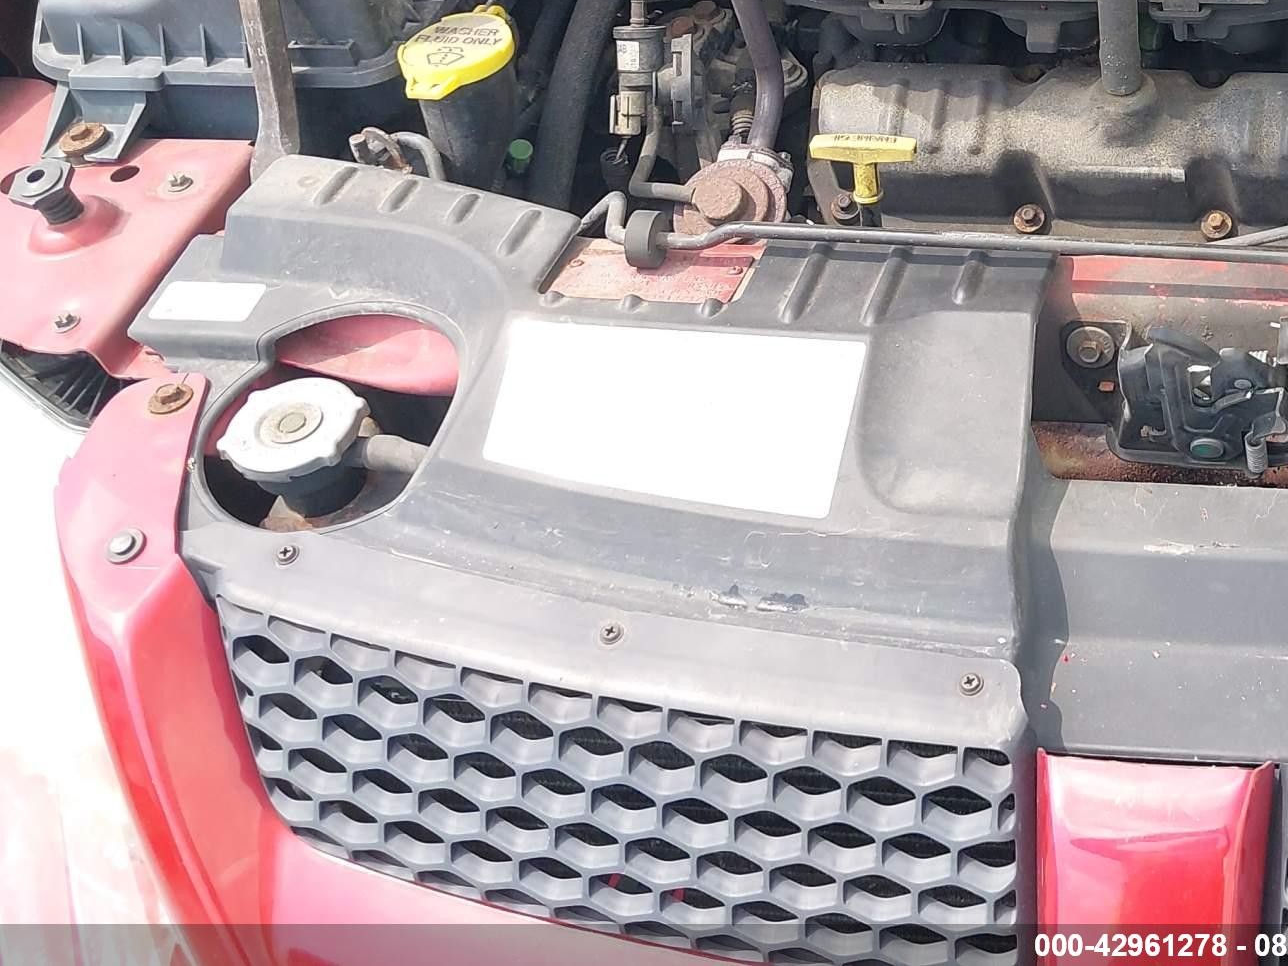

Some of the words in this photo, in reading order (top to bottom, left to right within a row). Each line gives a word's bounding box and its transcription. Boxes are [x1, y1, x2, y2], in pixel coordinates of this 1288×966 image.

[434, 26, 499, 36] WASHER
[415, 34, 458, 45] FLUID
[462, 36, 503, 46] ONLY
